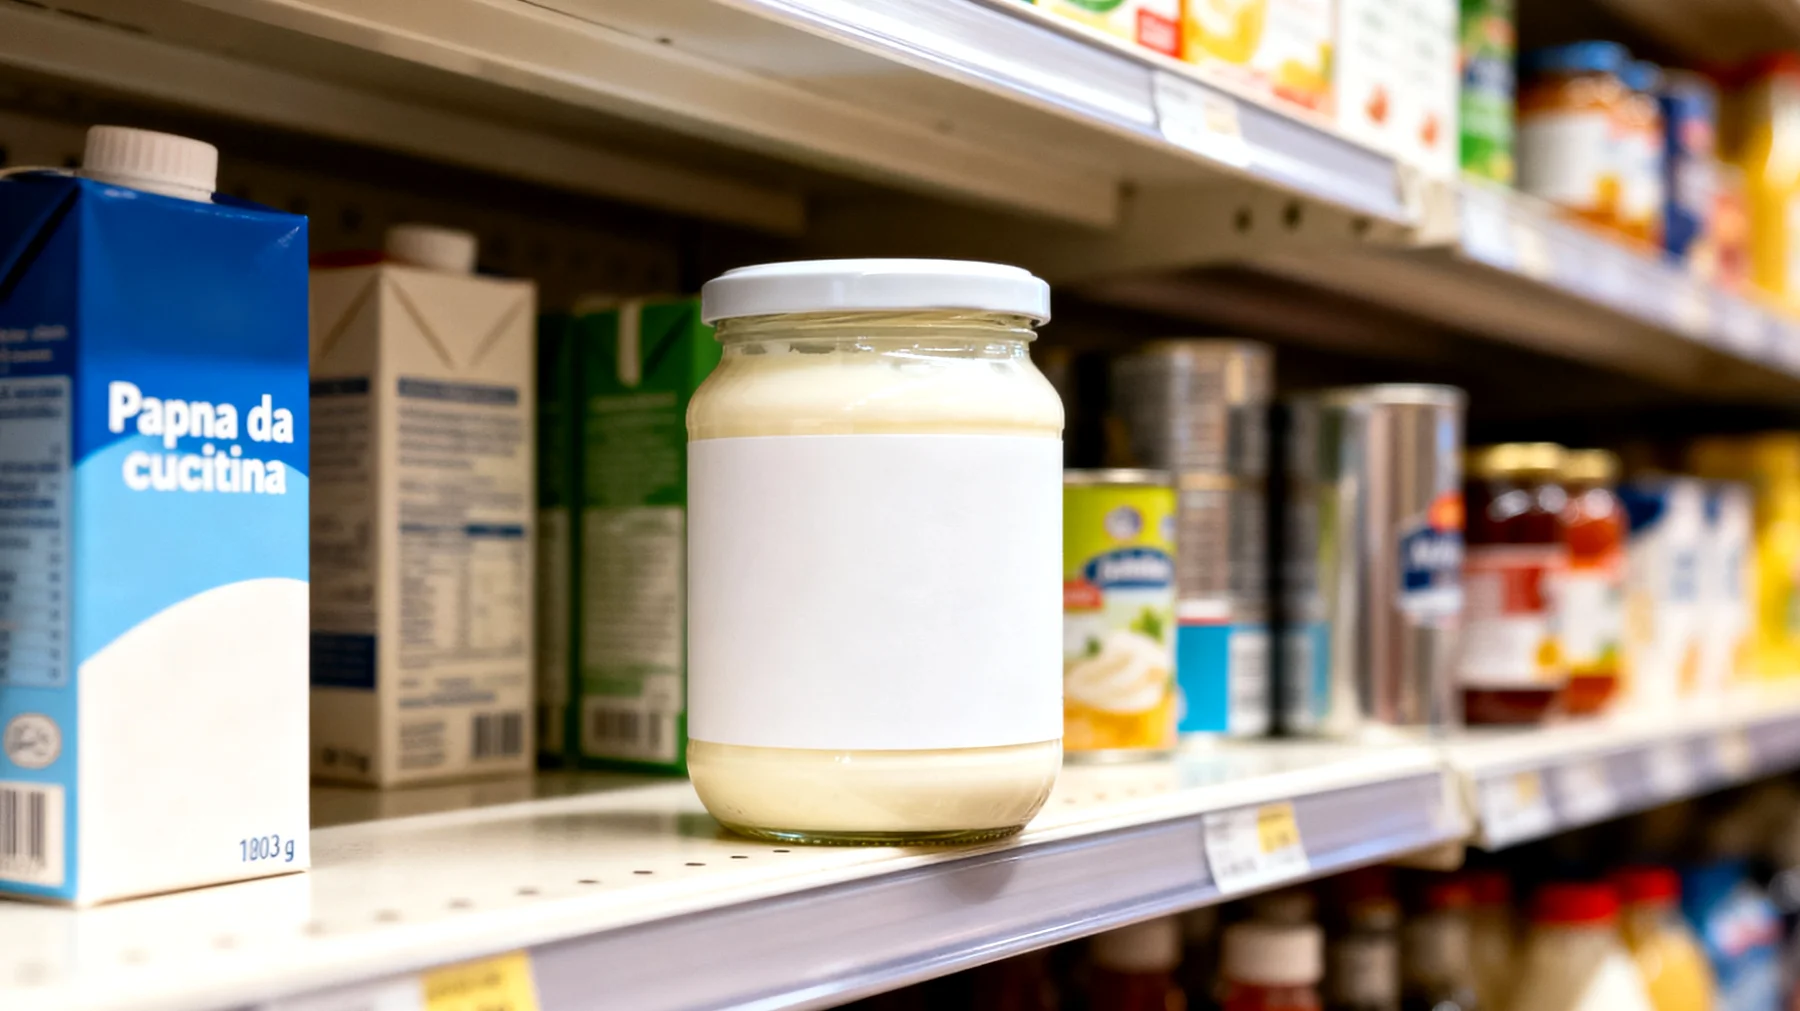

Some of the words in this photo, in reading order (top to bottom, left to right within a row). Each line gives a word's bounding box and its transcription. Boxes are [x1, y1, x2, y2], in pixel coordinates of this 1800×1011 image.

[108, 380, 238, 449] Papna
[246, 393, 294, 443] da
[122, 442, 287, 494] cucitina
[284, 839, 294, 862] g
